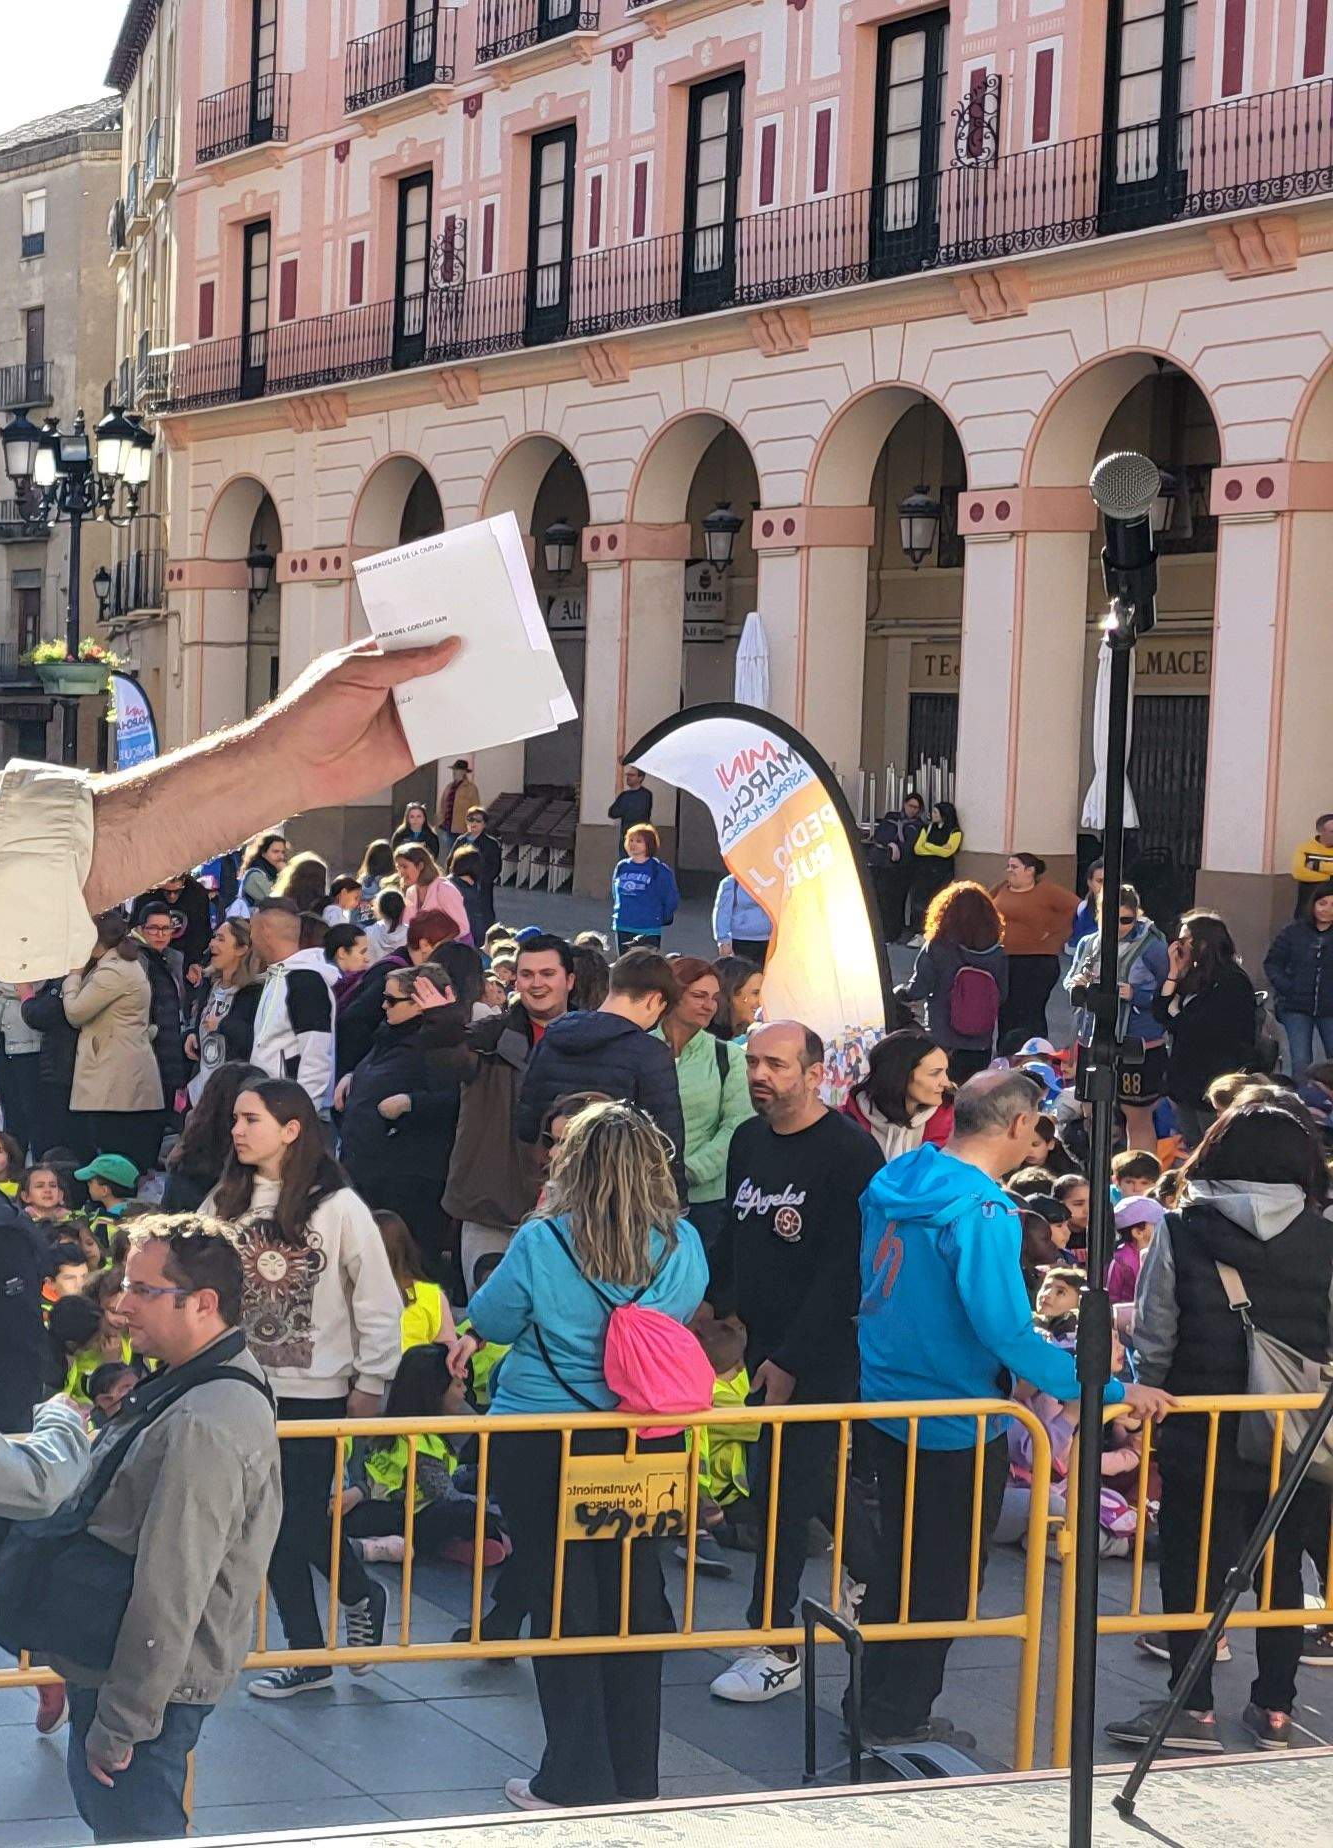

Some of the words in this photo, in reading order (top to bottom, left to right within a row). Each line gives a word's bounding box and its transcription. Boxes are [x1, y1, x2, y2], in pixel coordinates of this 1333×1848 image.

[401, 552, 410, 560] DE
[411, 550, 419, 558] LA
[420, 542, 444, 554] CIUDAD
[394, 627, 406, 635] DEL
[435, 615, 448, 623] SAN
[1135, 650, 1211, 676] LMACE
[1123, 1073, 1141, 1094] 88
[738, 1183, 806, 1221] Angeles
